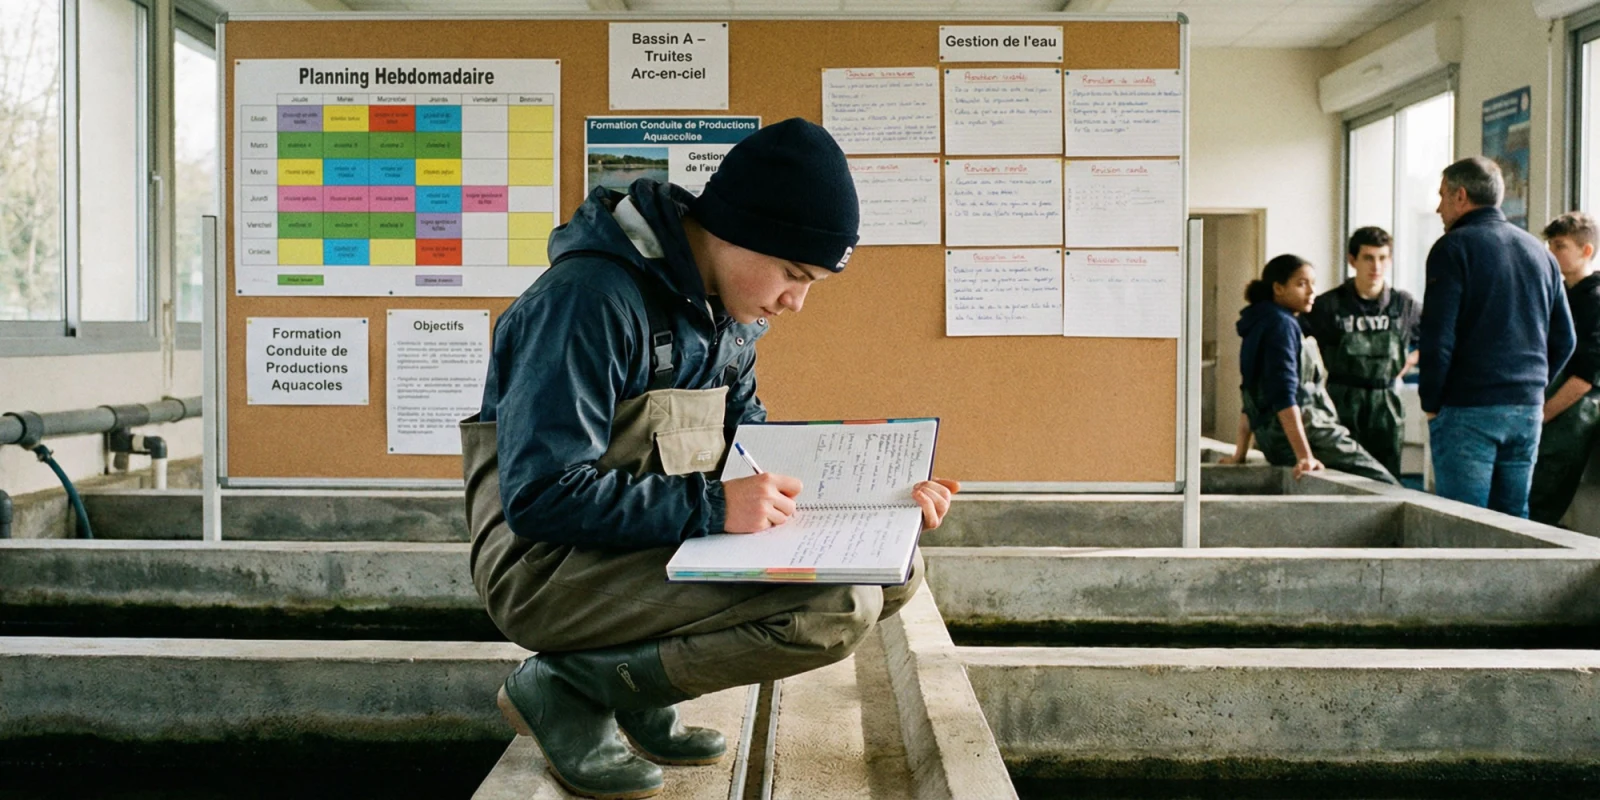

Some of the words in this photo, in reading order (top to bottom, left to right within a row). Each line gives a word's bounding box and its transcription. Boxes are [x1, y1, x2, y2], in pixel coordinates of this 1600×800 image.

[632, 33, 679, 45] Bassin
[682, 33, 694, 45] A
[945, 35, 999, 48] Gestion
[1002, 35, 1020, 48] de
[1024, 35, 1057, 48] l'eau
[644, 50, 693, 63] Truites
[299, 67, 369, 89] Planning
[375, 67, 495, 85] Hebdomadaire
[631, 67, 706, 80] Arc-en-ciel
[590, 120, 638, 130] Formation
[640, 120, 682, 130] Conduite
[684, 120, 697, 130] de
[698, 120, 756, 130] Productions
[688, 152, 725, 161] Gestion
[685, 164, 697, 172] de
[272, 327, 342, 340] Formation
[413, 320, 464, 334] Objectifs
[265, 345, 328, 357] Conduite
[331, 345, 348, 357] de
[266, 362, 349, 374] Productions
[271, 379, 343, 393] Aquacoles
